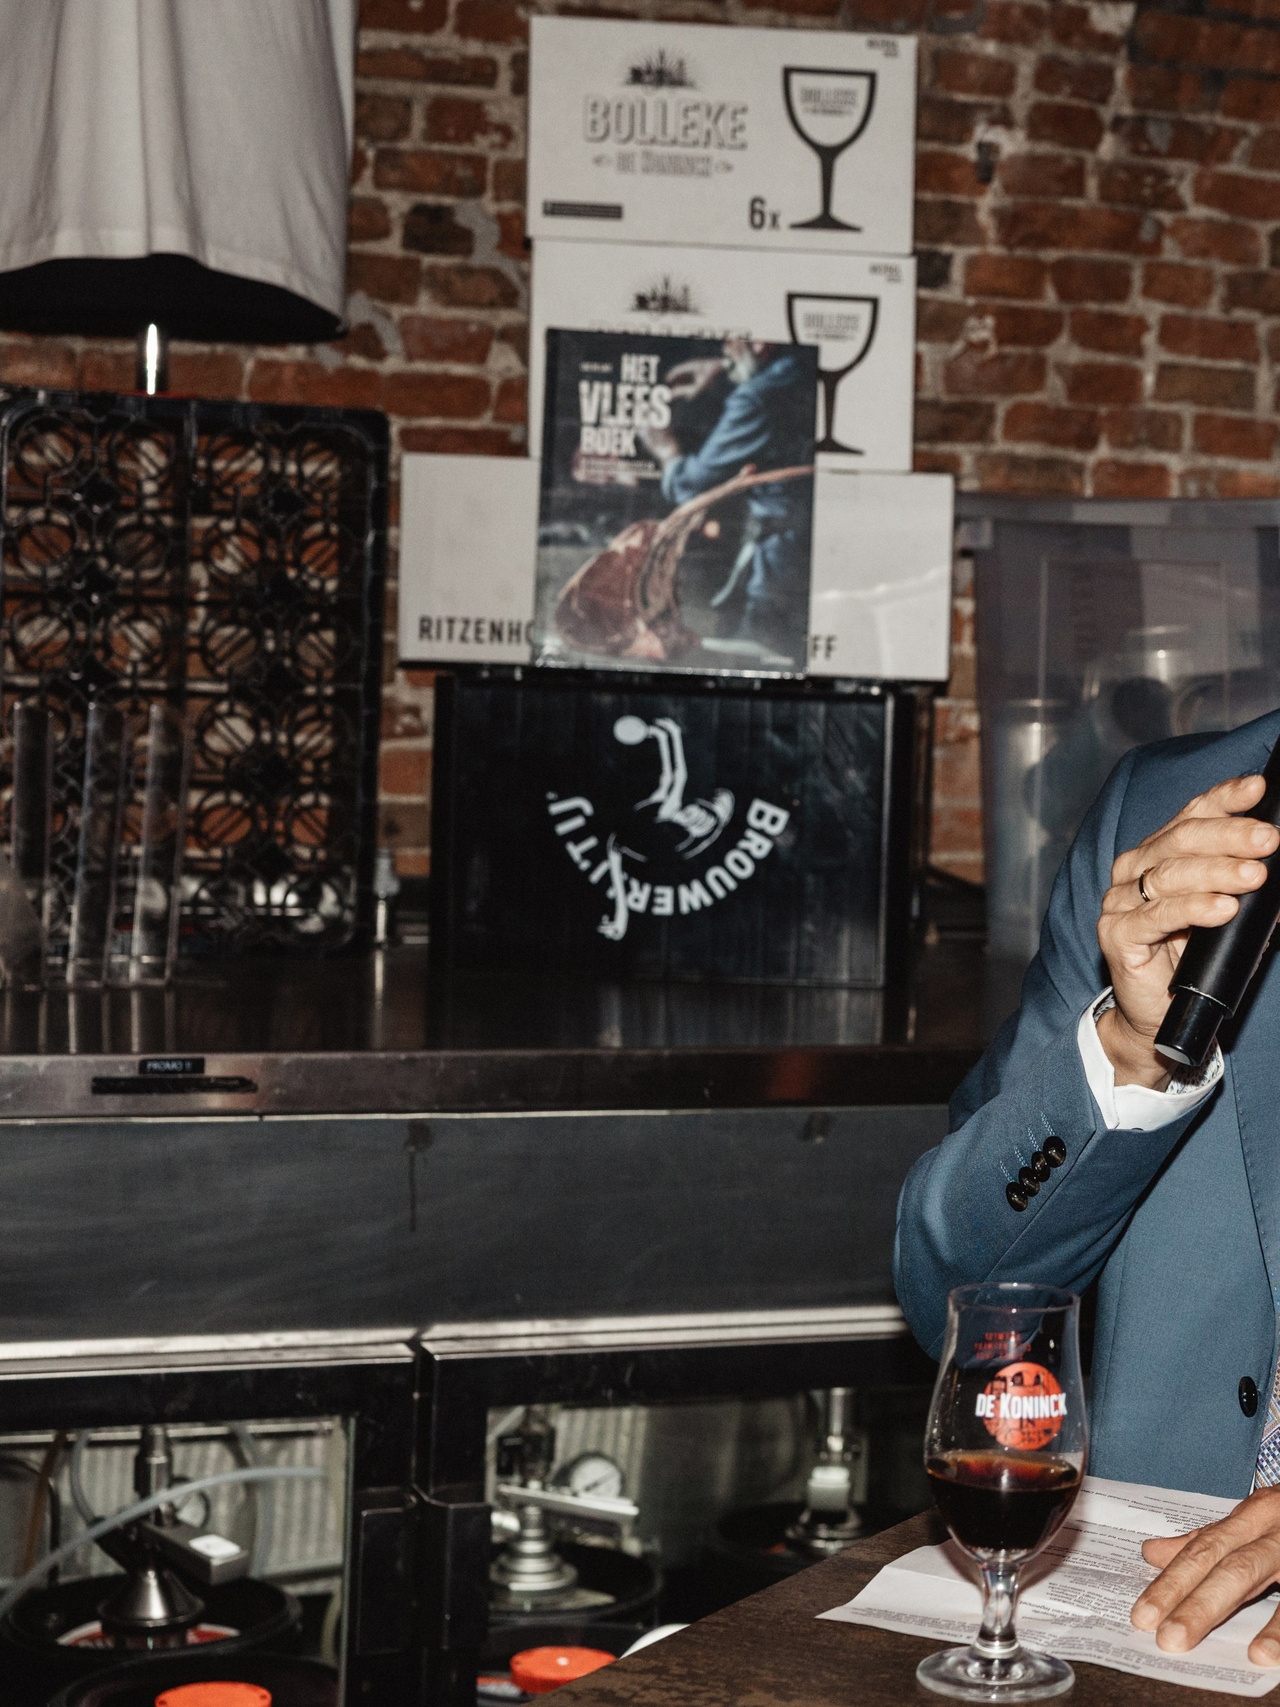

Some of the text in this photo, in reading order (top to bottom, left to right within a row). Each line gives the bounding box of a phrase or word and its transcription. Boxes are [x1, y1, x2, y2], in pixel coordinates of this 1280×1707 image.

[583, 95, 748, 150] BOLLEKE
[621, 353, 660, 383] HET
[579, 380, 671, 428] VLEES
[580, 426, 637, 458] BOEK
[975, 1392, 1067, 1419] DE KONINCK
